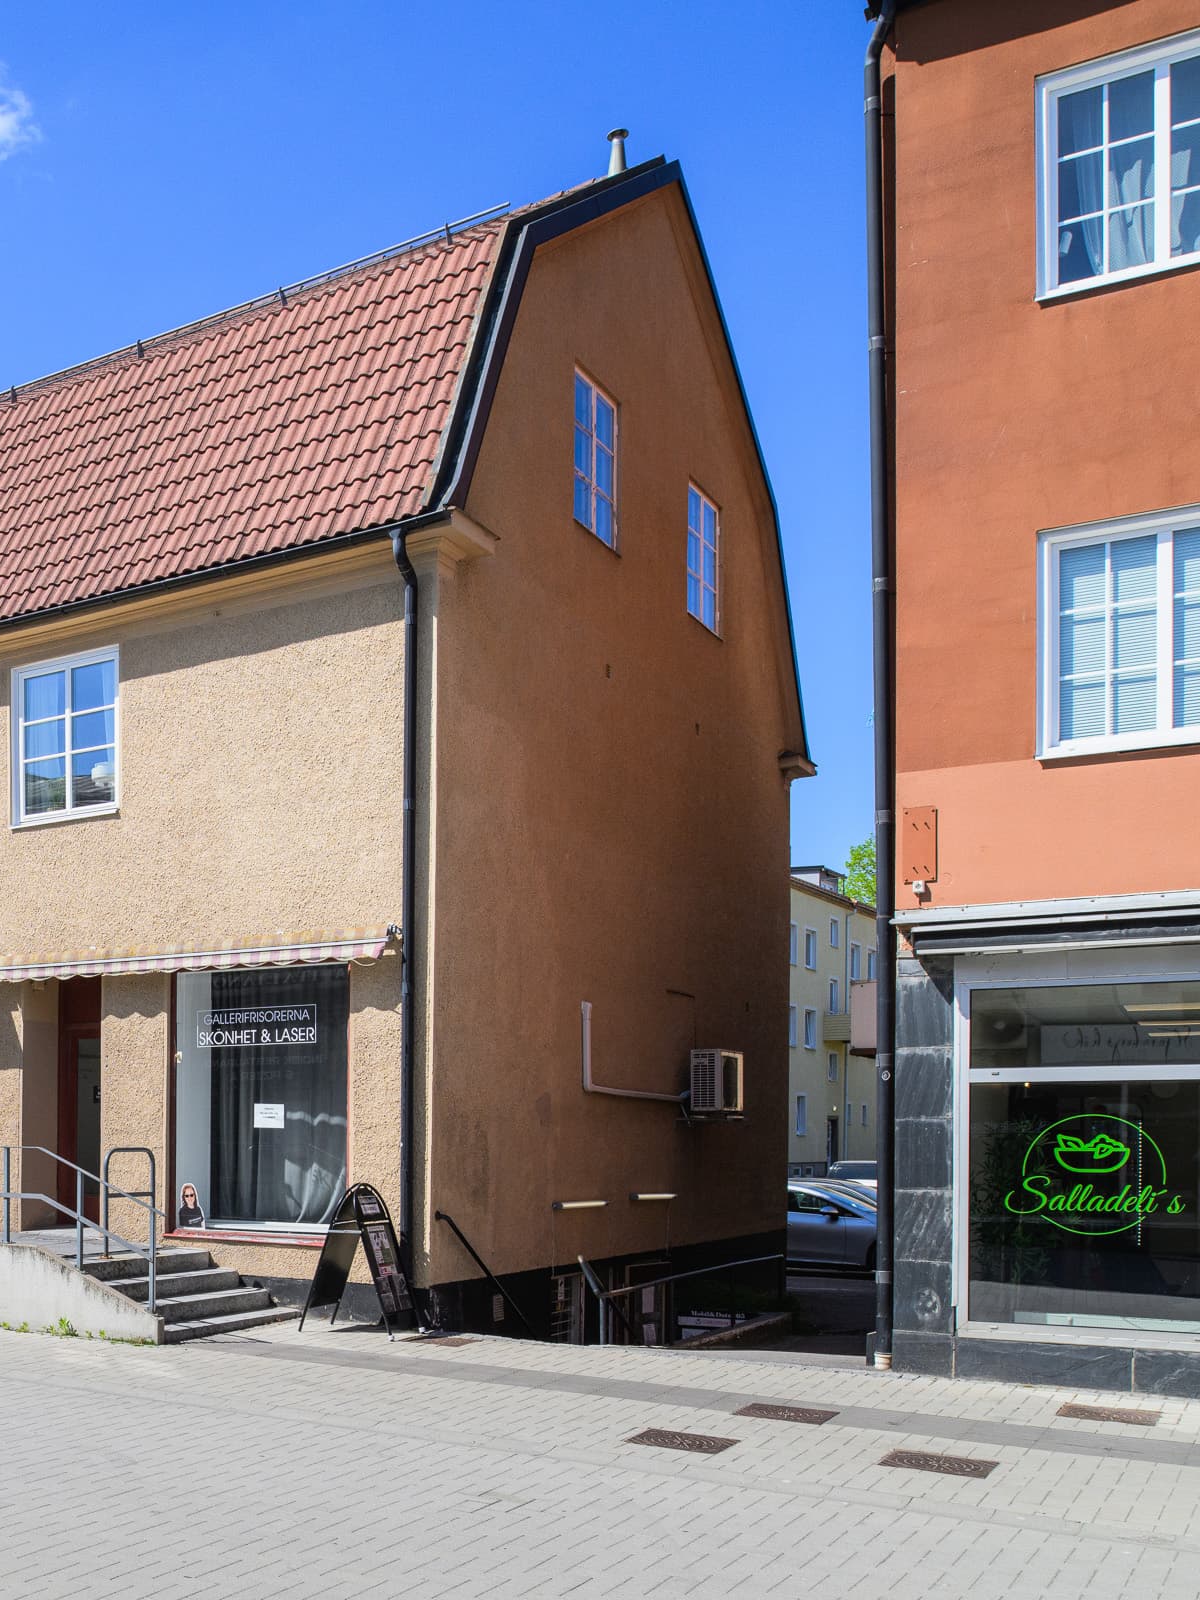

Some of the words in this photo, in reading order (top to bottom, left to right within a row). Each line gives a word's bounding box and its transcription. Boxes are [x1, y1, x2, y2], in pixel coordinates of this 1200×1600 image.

[203, 1009, 310, 1026] GALLERIFRISORERNA
[199, 1028, 257, 1045] SKÖNHET
[261, 1029, 271, 1042] &
[275, 1027, 315, 1042] LASER
